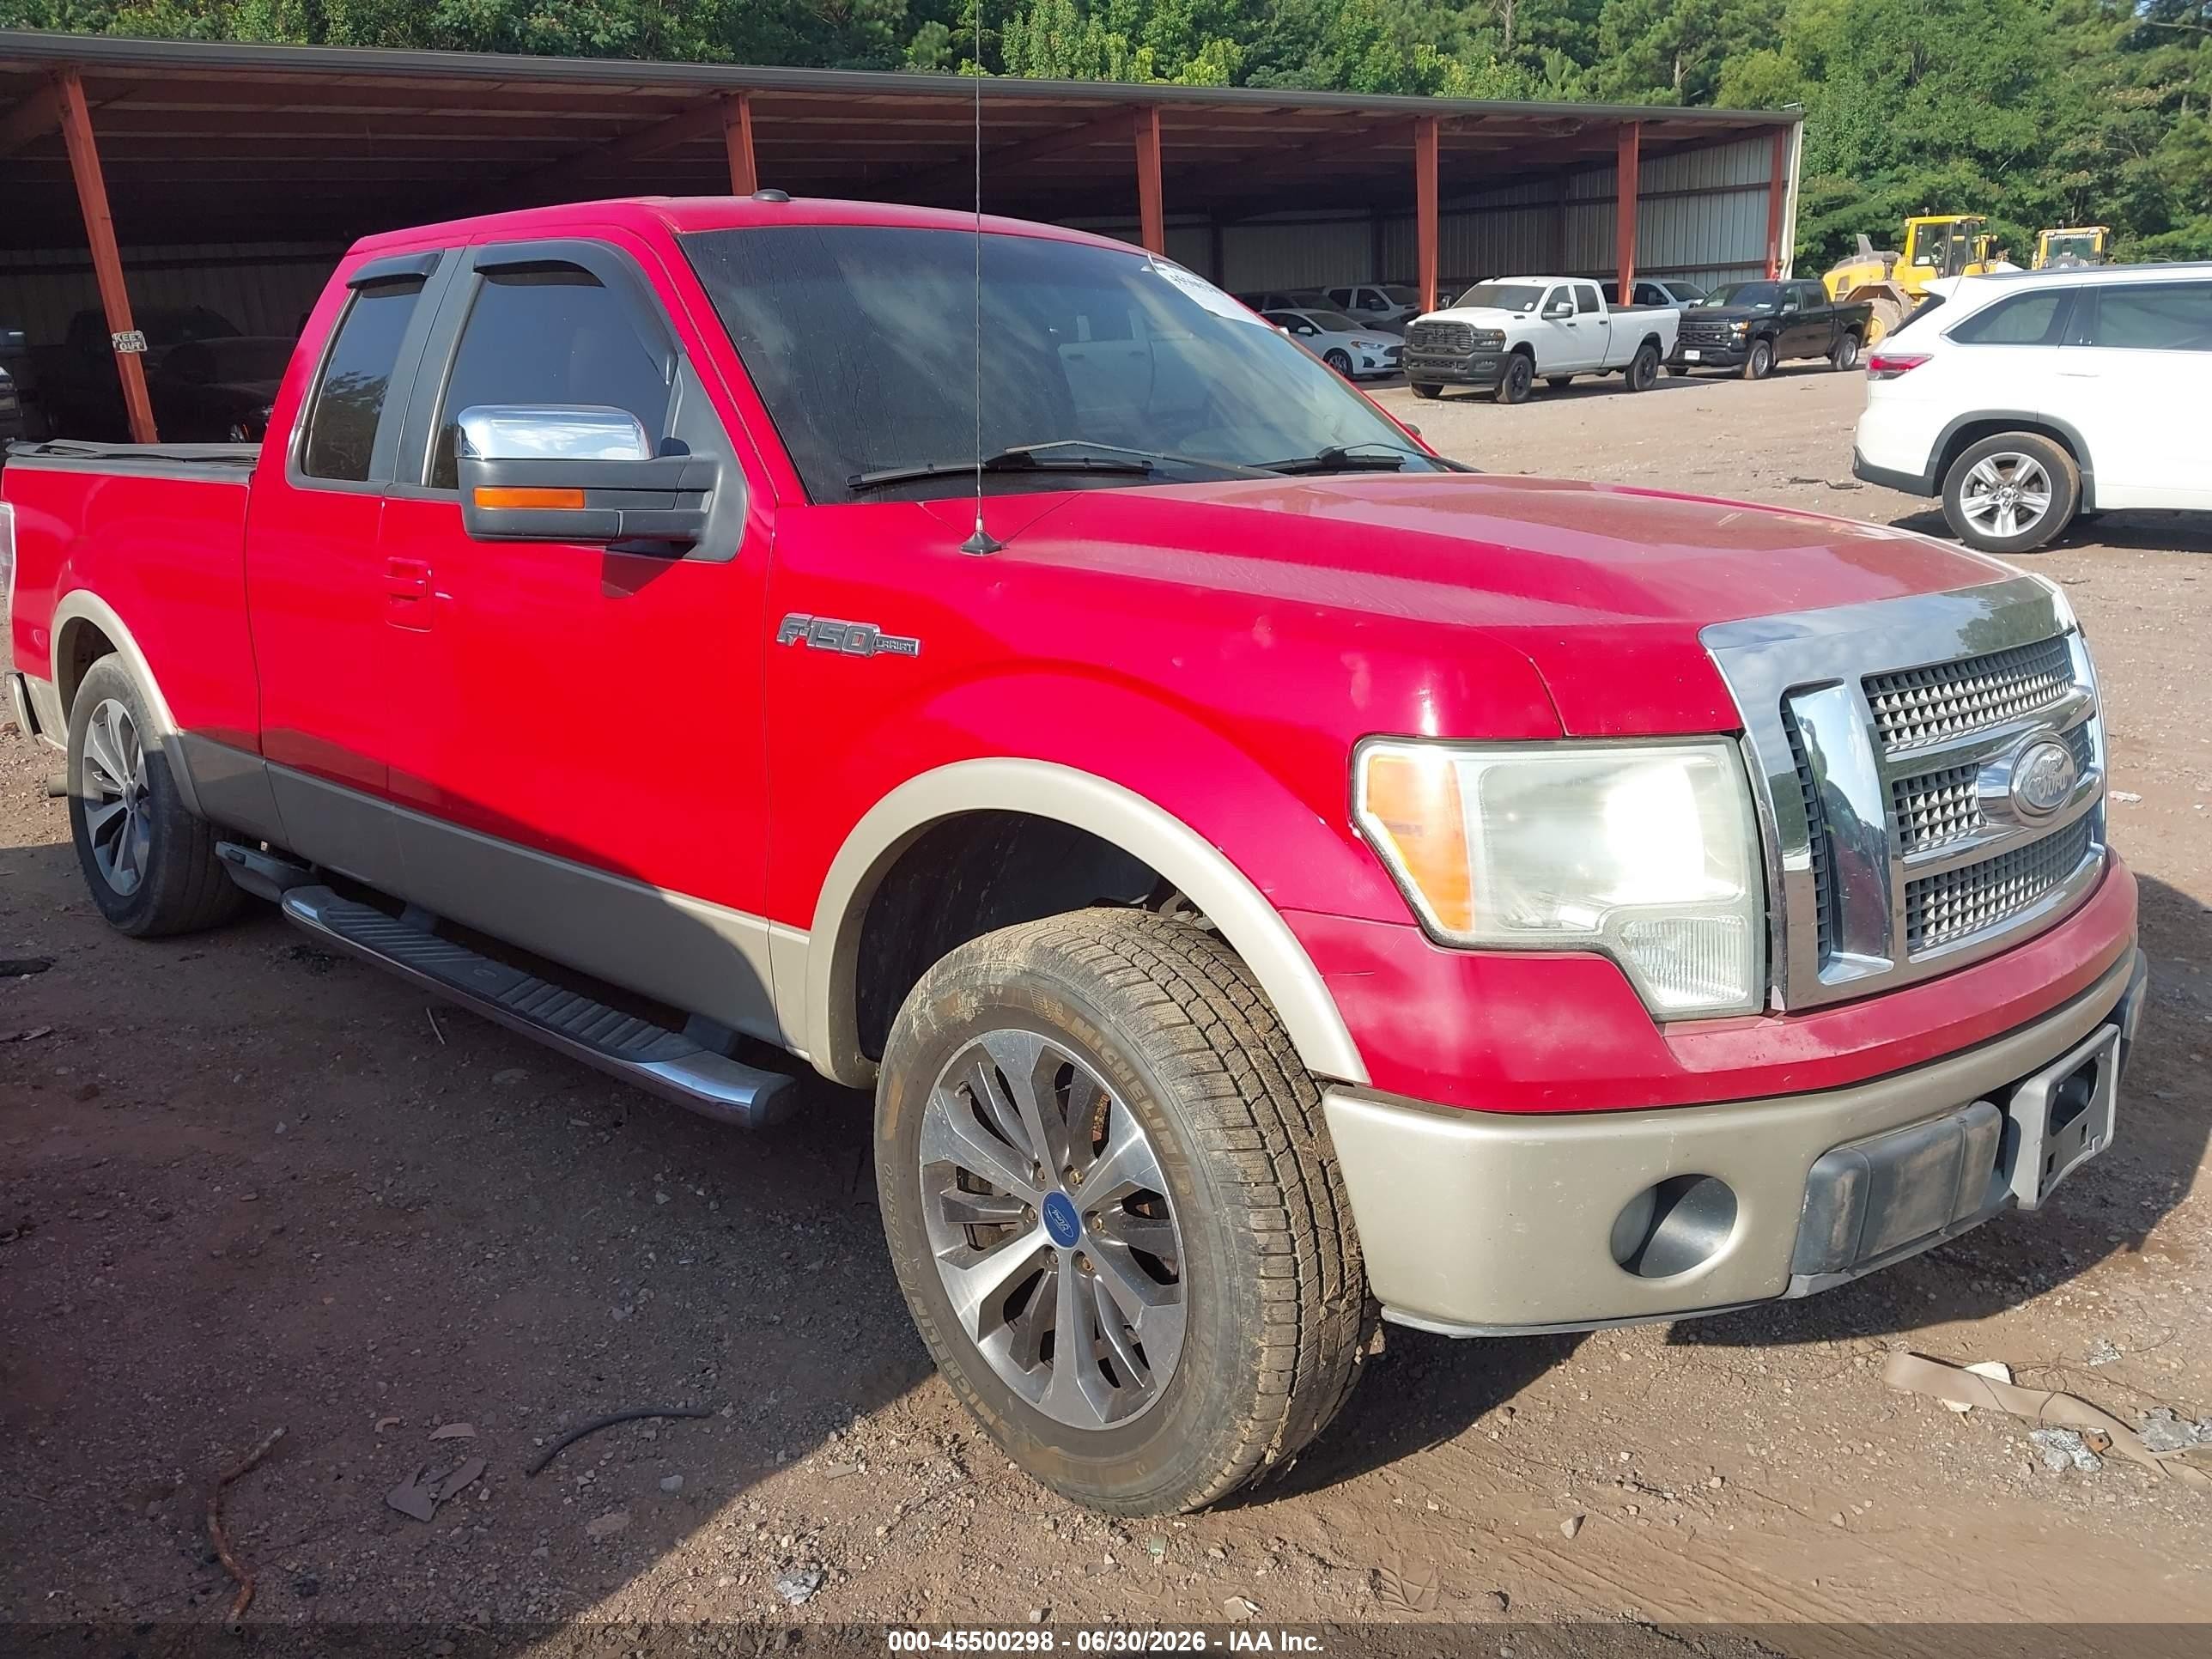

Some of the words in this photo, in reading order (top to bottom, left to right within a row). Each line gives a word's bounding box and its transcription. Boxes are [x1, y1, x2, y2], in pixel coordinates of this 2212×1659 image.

[119, 341, 142, 351] OUT
[1071, 1016, 1178, 1154] MICHELIN
[911, 1295, 997, 1426] MICHELIN
